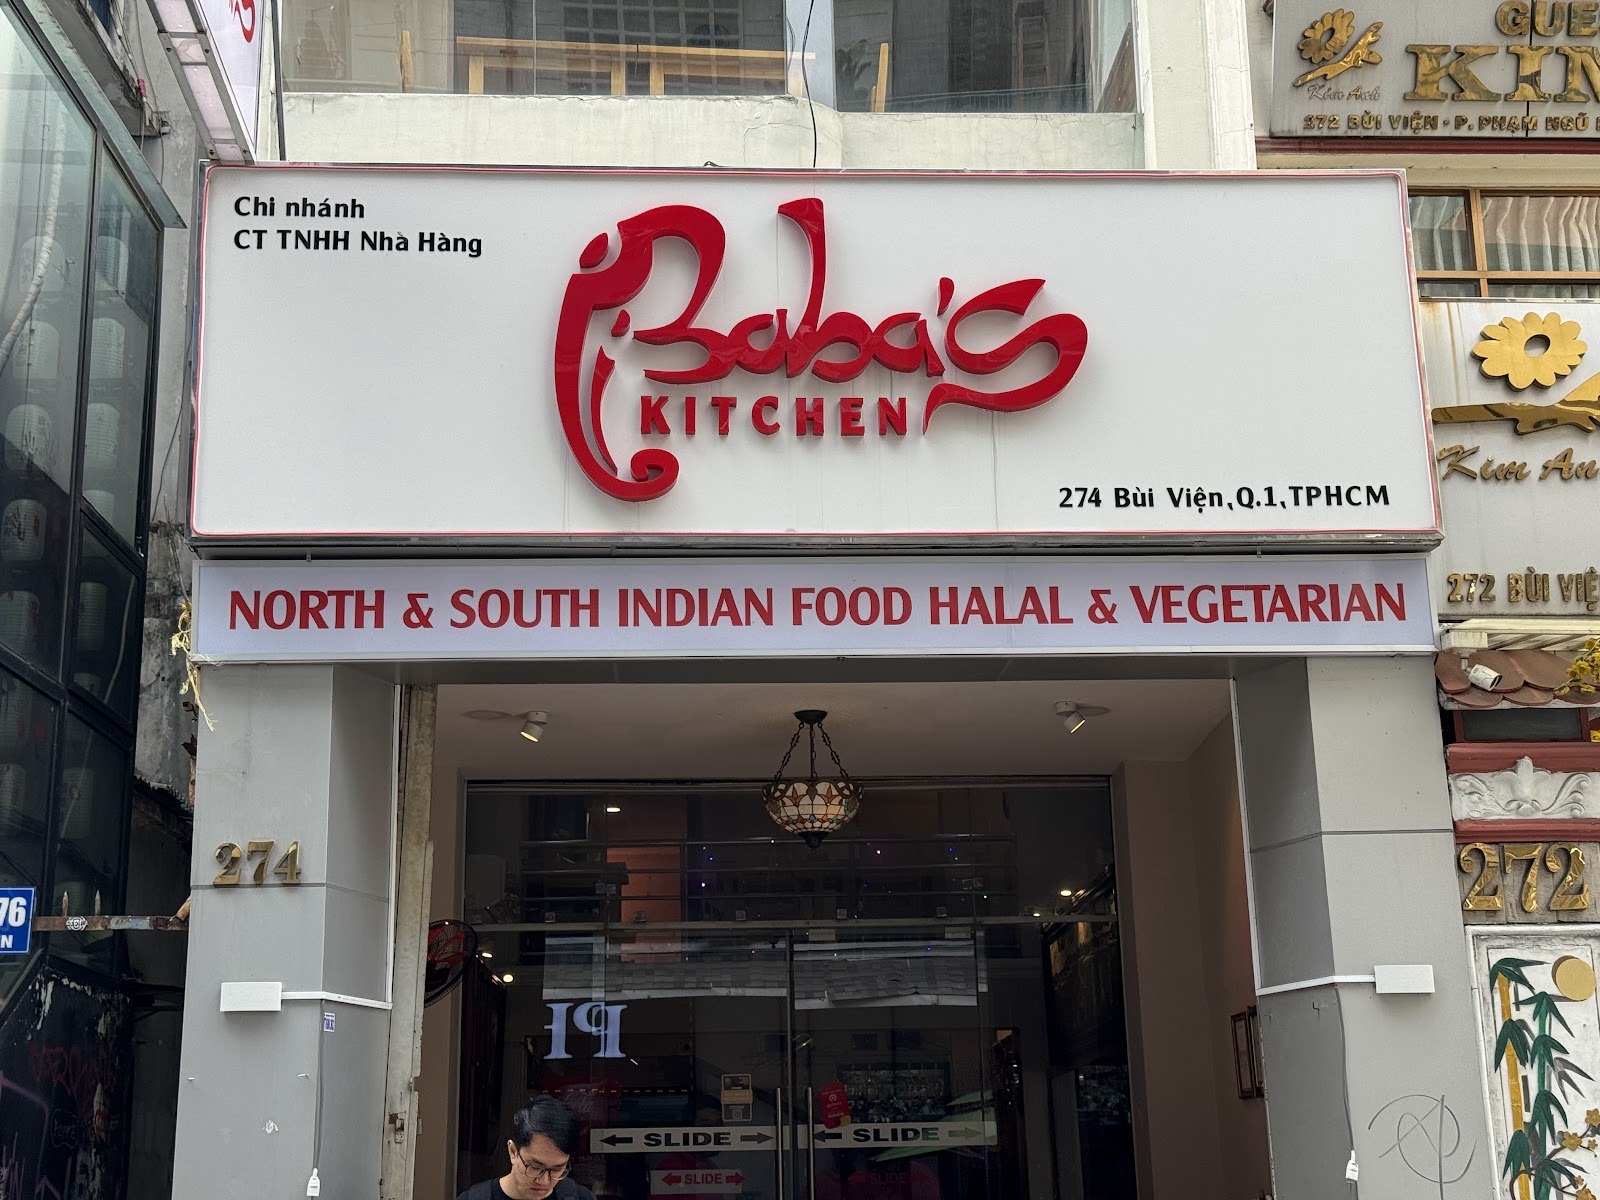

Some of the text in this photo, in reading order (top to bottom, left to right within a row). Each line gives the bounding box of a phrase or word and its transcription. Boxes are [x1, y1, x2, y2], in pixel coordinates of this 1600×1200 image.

[1495, 0, 1600, 38] GUE
[1307, 84, 1381, 101] Kim Anh
[1303, 110, 1590, 134] 272 BÙI VIỆN P. PHẠM NGŨ
[234, 197, 365, 218] Chi nhánh
[234, 230, 482, 257] CT TNHH Nhà Hàng
[554, 197, 1089, 501] Baba's
[640, 395, 908, 438] KITCHEN
[1437, 444, 1600, 480] Kim An
[1059, 487, 1102, 508] 274
[1114, 486, 1155, 508] Bùi
[1448, 566, 1600, 611] 272 BÙI VIỆ
[230, 583, 1407, 630] NORTH & SOUTH INDIAN FOOD HALAL & VEGETARIAN
[213, 841, 302, 885] 274
[1459, 842, 1590, 913] 272
[643, 1131, 733, 1147] SLIDE
[853, 1127, 940, 1142] SLIDE
[684, 1172, 723, 1185] SLIDE
